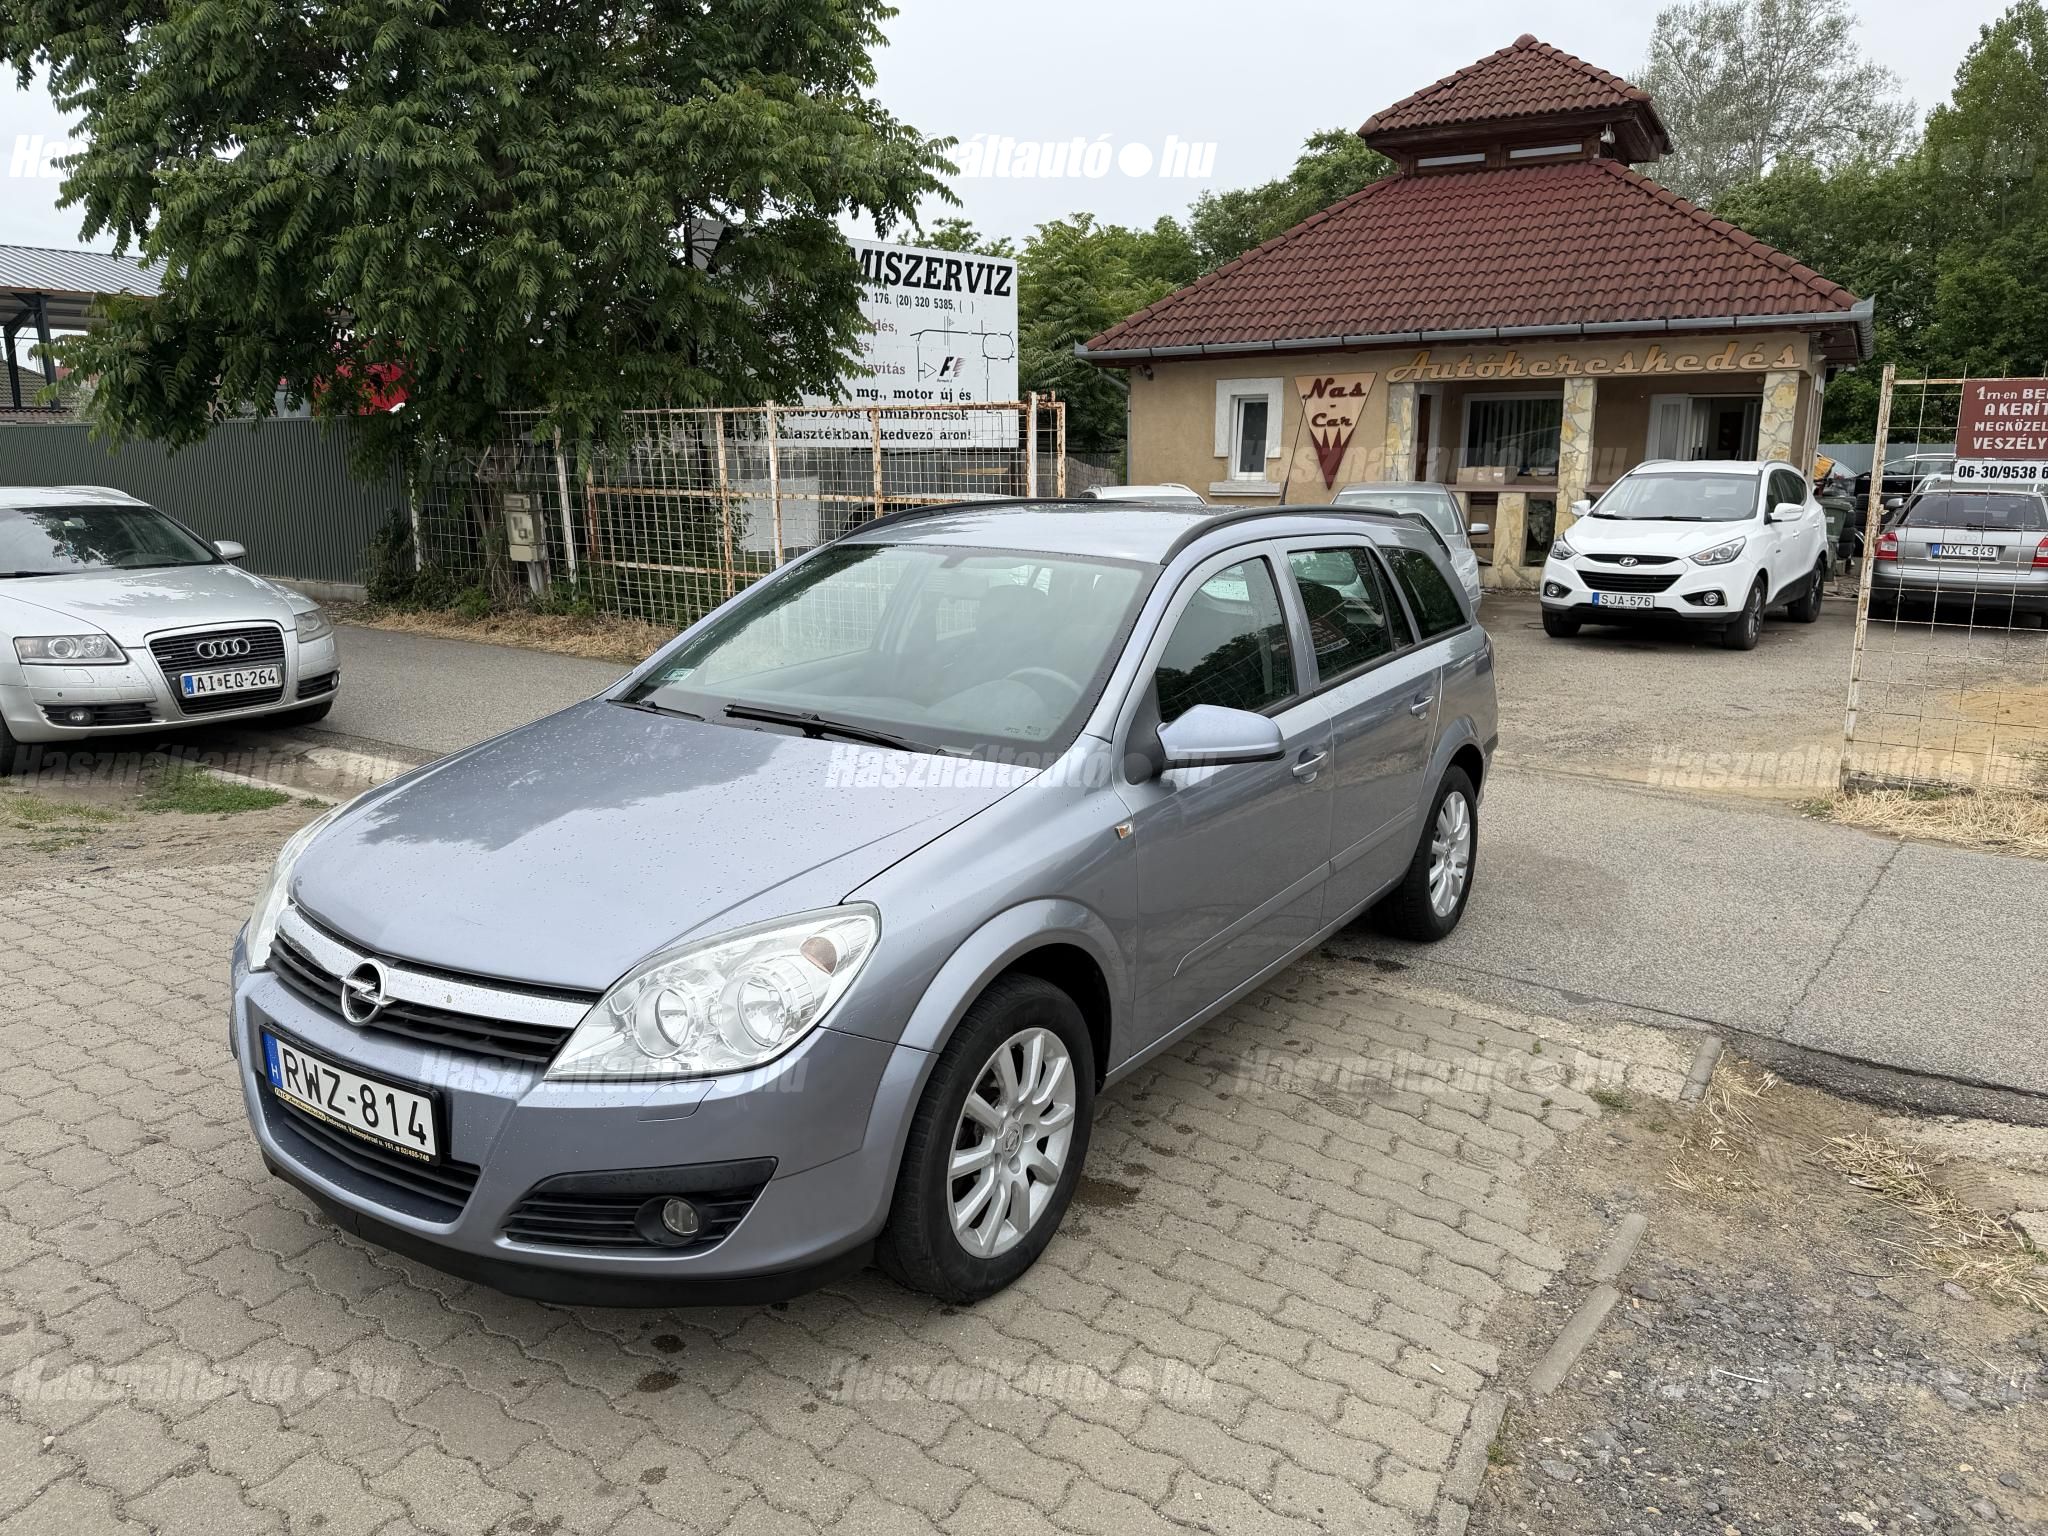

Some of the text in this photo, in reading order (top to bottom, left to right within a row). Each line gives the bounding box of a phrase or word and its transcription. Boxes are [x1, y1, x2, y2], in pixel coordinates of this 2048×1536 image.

[874, 292, 892, 304] 176.
[896, 294, 912, 308] (20)
[914, 296, 930, 308] 320
[934, 298, 956, 312] 5385,
[1386, 341, 1801, 384] Autókereskedés
[856, 388, 886, 400] mg.,
[893, 388, 934, 400] motor
[941, 387, 952, 402] új
[959, 387, 972, 400] és
[1302, 377, 1366, 399] Nas
[2022, 388, 2048, 400] BE
[1984, 403, 1996, 416] A
[1311, 412, 1352, 428] Car
[1974, 418, 2048, 432] MEGKÖZEL
[880, 428, 933, 440] kedvező
[940, 428, 971, 440] áron!
[1973, 434, 2047, 450] VESZÉLY
[1958, 466, 2037, 478] 06-30/9538
[1942, 545, 1994, 556] NXL-849
[1601, 594, 1651, 606] SJA-576
[282, 1048, 427, 1146] RWZ-814
